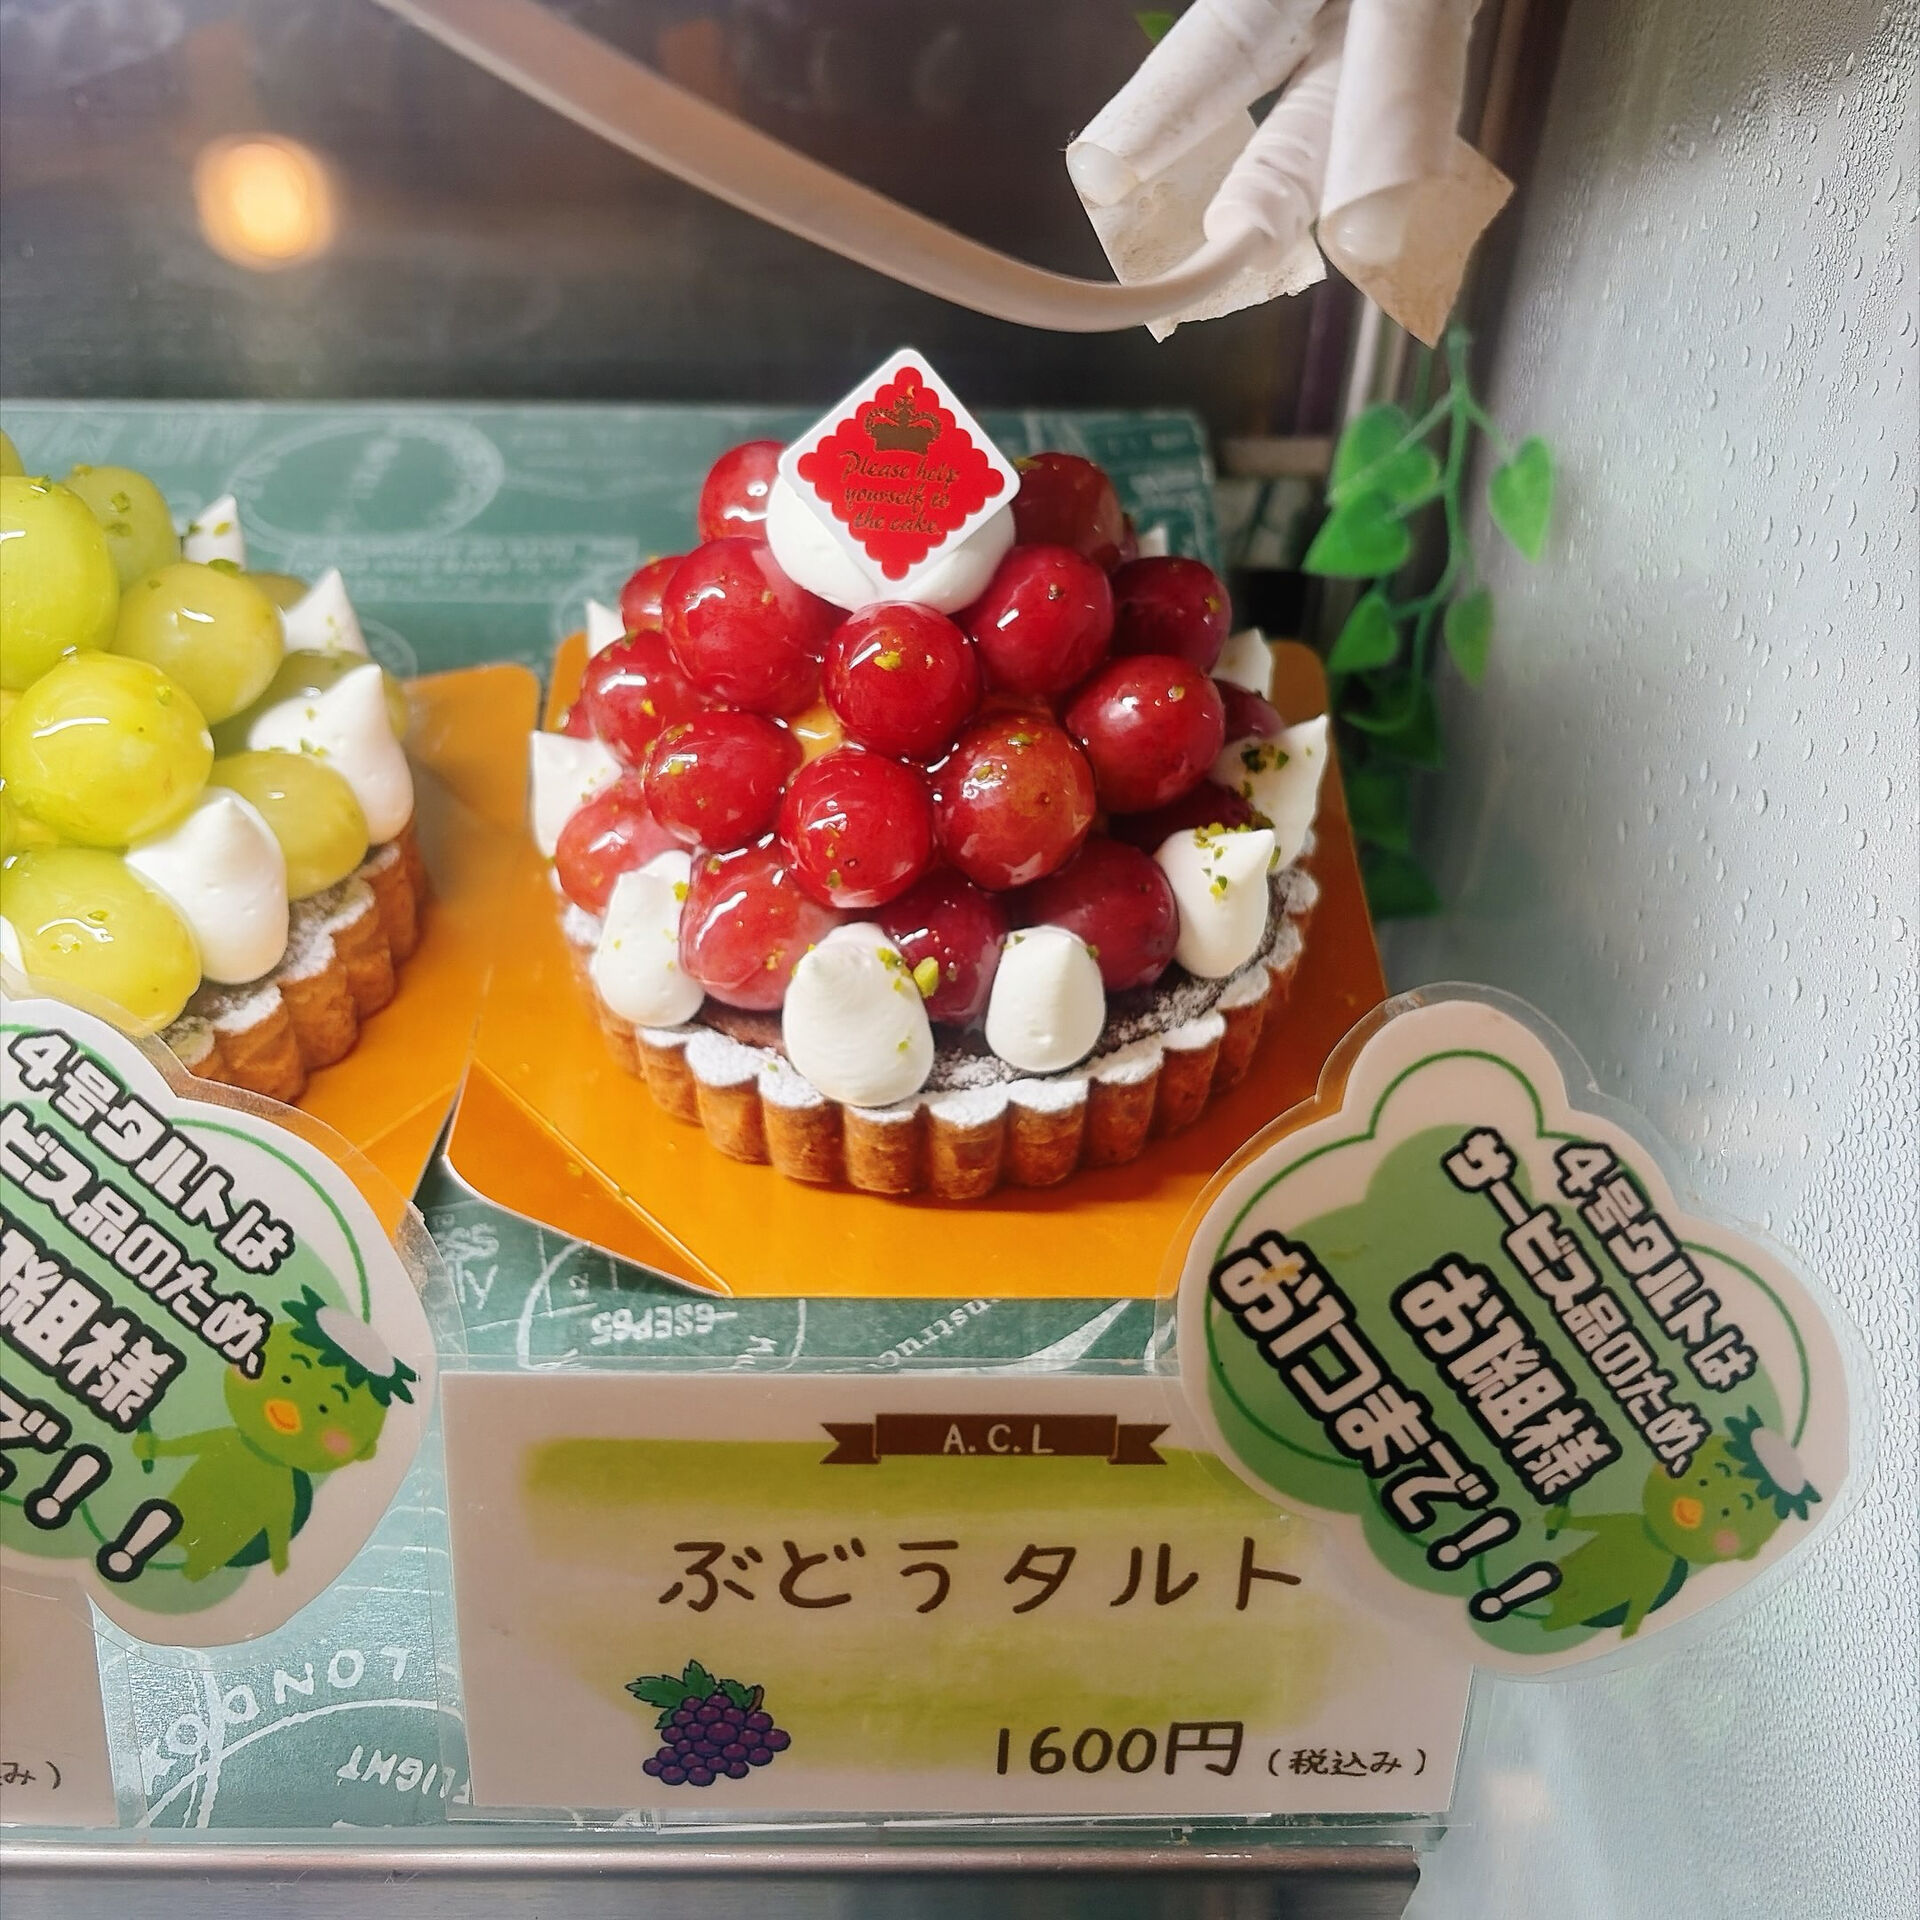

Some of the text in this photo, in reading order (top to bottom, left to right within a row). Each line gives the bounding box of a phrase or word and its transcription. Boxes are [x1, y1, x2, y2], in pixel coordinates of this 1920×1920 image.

[839, 450, 960, 490] Please help
[844, 483, 950, 515] yourself to
[854, 506, 885, 531] the
[8, 1027, 296, 1276] 4号タルトは
[1554, 1141, 1759, 1392] 4号タルトは
[872, 1299, 997, 1369] nstruc
[1441, 1127, 1712, 1478] サービス品のため、
[658, 1536, 1303, 1614] ぶどうタルト
[996, 1720, 1244, 1777] 1600円
